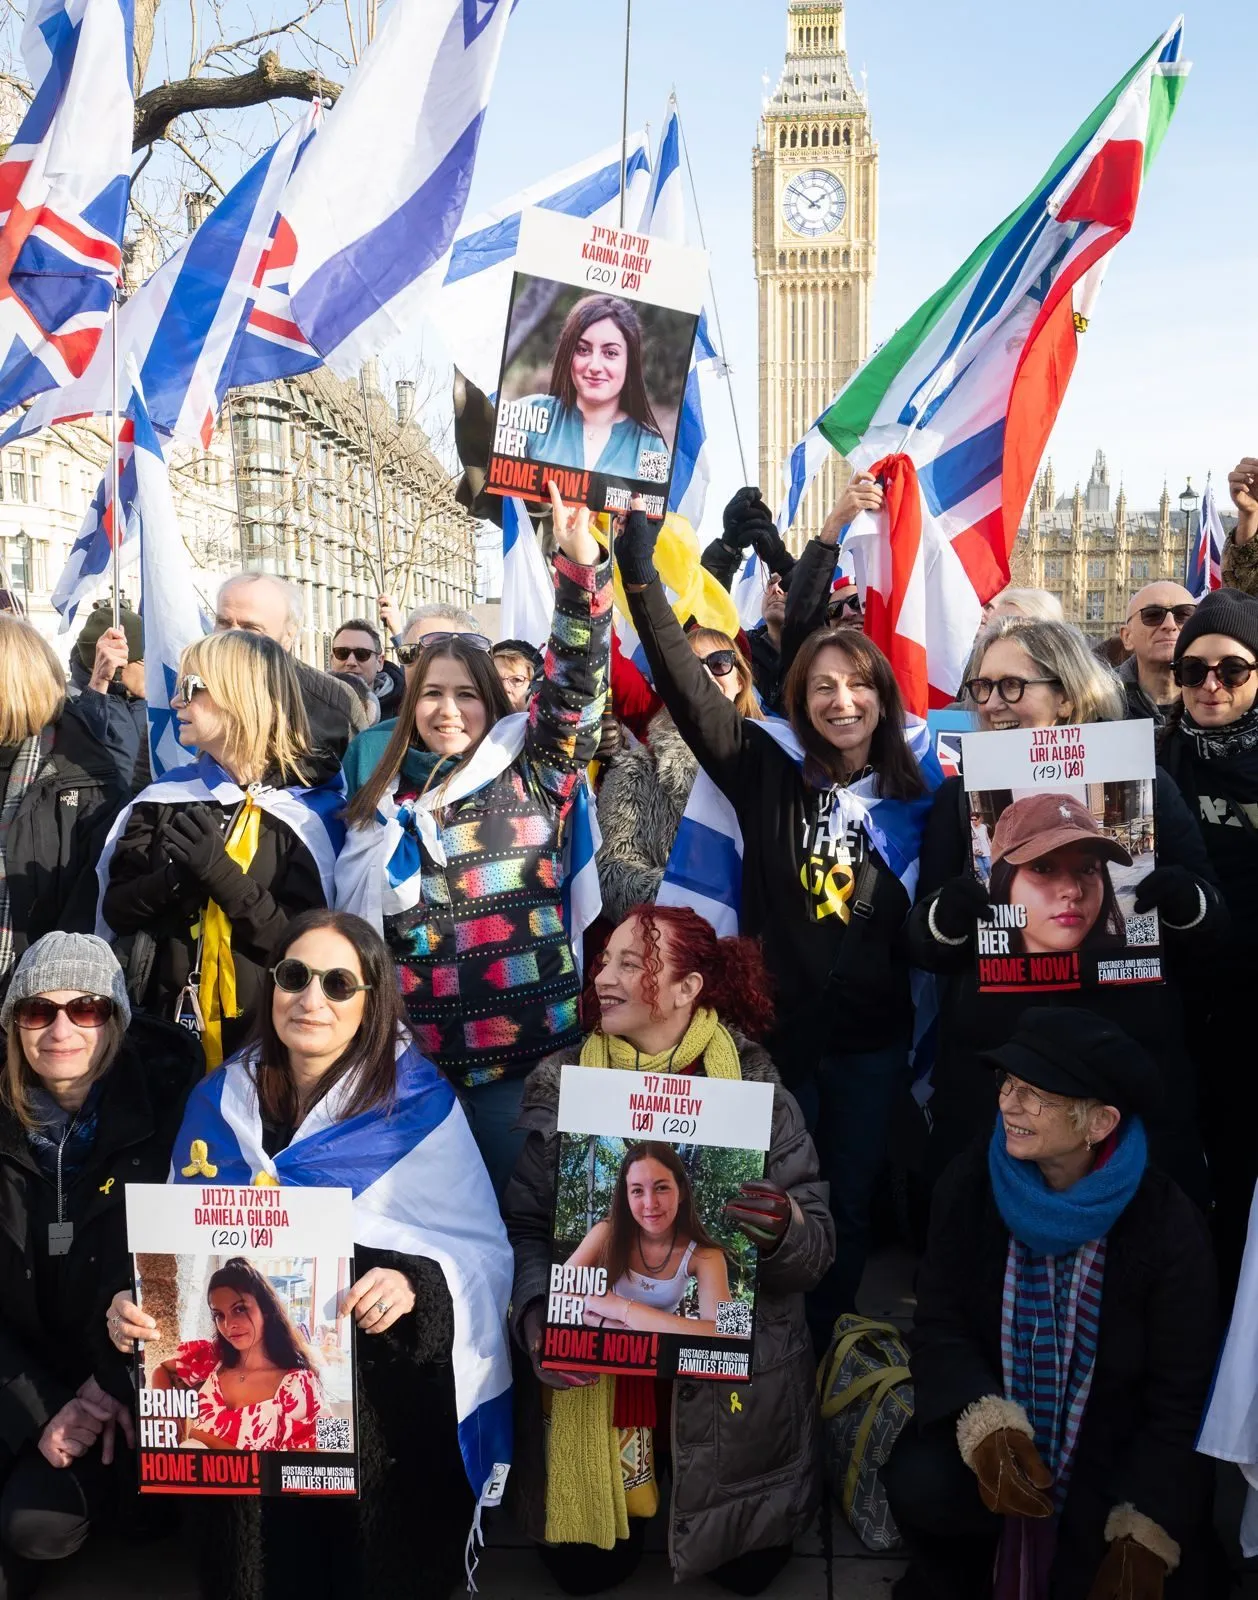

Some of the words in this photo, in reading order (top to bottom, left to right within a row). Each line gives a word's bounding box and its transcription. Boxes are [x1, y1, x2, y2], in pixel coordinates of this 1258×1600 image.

[590, 225, 618, 248] ארייב
[620, 233, 650, 256] קרינה
[581, 242, 619, 267] KARINA
[621, 253, 652, 274] ARIEV
[586, 265, 617, 287] (20)
[498, 399, 549, 434] BRING
[493, 429, 528, 458] HER
[490, 457, 539, 491] HOME
[541, 467, 590, 500] NOW!
[646, 503, 664, 515] RUM
[1032, 729, 1058, 746] אלבג
[1060, 727, 1081, 743] לירי
[1030, 747, 1049, 763] LIRI
[1052, 744, 1085, 761] ALBAG
[1033, 764, 1062, 782] (19)
[978, 930, 1010, 955] HER
[979, 959, 1025, 983] HOME
[1031, 954, 1080, 981] NOW!
[1097, 959, 1124, 970] HOSTAGES
[1124, 959, 1136, 969] AND
[1136, 957, 1160, 968] MISSING
[1098, 968, 1133, 982] FAMILIES
[1134, 966, 1162, 980] FORUM
[643, 1075, 660, 1093] לוי
[663, 1077, 691, 1097] נעמה
[629, 1093, 671, 1113] NAAMA
[674, 1097, 703, 1116] LEVY
[662, 1117, 697, 1137] (20)
[202, 1187, 236, 1206] גלבוע
[239, 1188, 281, 1207] דניאלה
[194, 1208, 244, 1226] DANIELA
[247, 1209, 290, 1227] GILBOA
[211, 1229, 247, 1249] (20)
[550, 1263, 608, 1296] BRING
[547, 1295, 584, 1325] HER
[544, 1327, 598, 1360] HOME
[603, 1332, 659, 1365] NOW!
[679, 1347, 710, 1360] HOSTAGES
[710, 1350, 723, 1361] AND
[723, 1351, 749, 1363] MISSING
[678, 1357, 716, 1374] FAMILIES
[717, 1361, 748, 1377] FORUM
[139, 1388, 199, 1419] BRING
[140, 1419, 179, 1448] HER
[142, 1453, 197, 1482] HOME
[202, 1452, 260, 1484] NOW!
[281, 1465, 313, 1476] HOSTAGES
[313, 1466, 326, 1477] AND
[327, 1467, 354, 1477] MISSING
[281, 1476, 322, 1490] FAMILIES
[323, 1476, 354, 1491] FORUM
[487, 1482, 501, 1496] F
